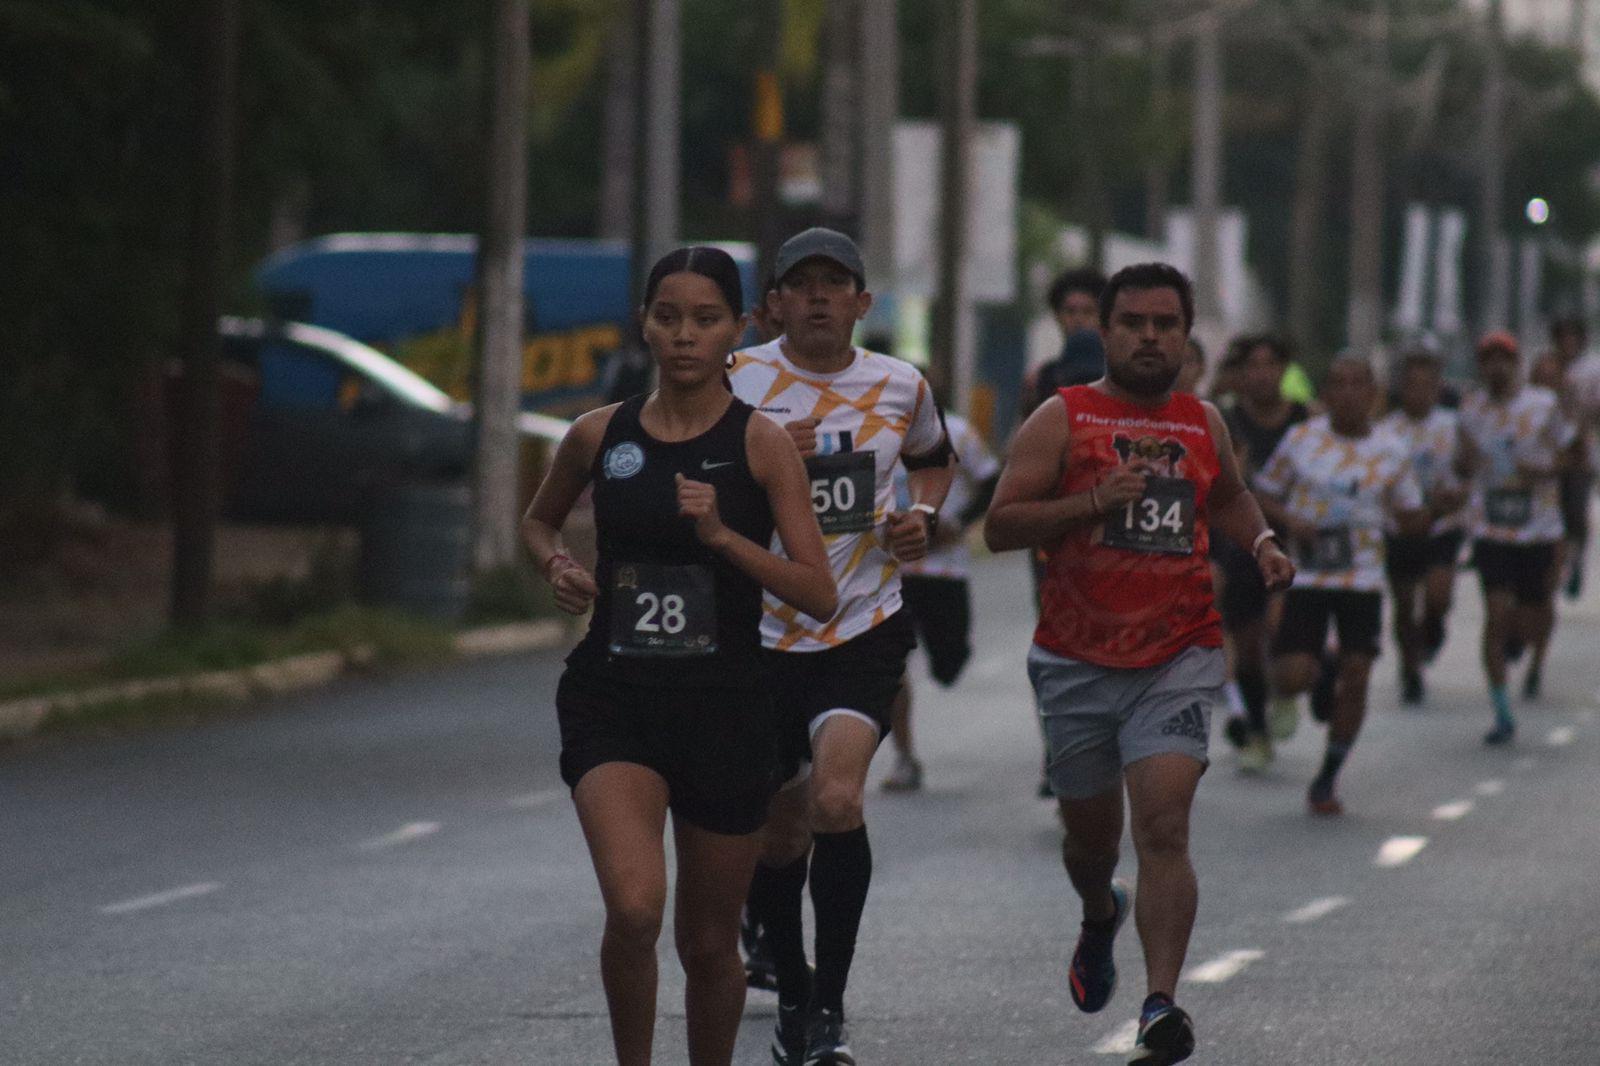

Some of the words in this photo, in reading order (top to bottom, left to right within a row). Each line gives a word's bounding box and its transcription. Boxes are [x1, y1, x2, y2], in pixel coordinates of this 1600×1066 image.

[811, 476, 855, 513] 50
[1125, 497, 1183, 533] 134
[635, 592, 686, 634] 28
